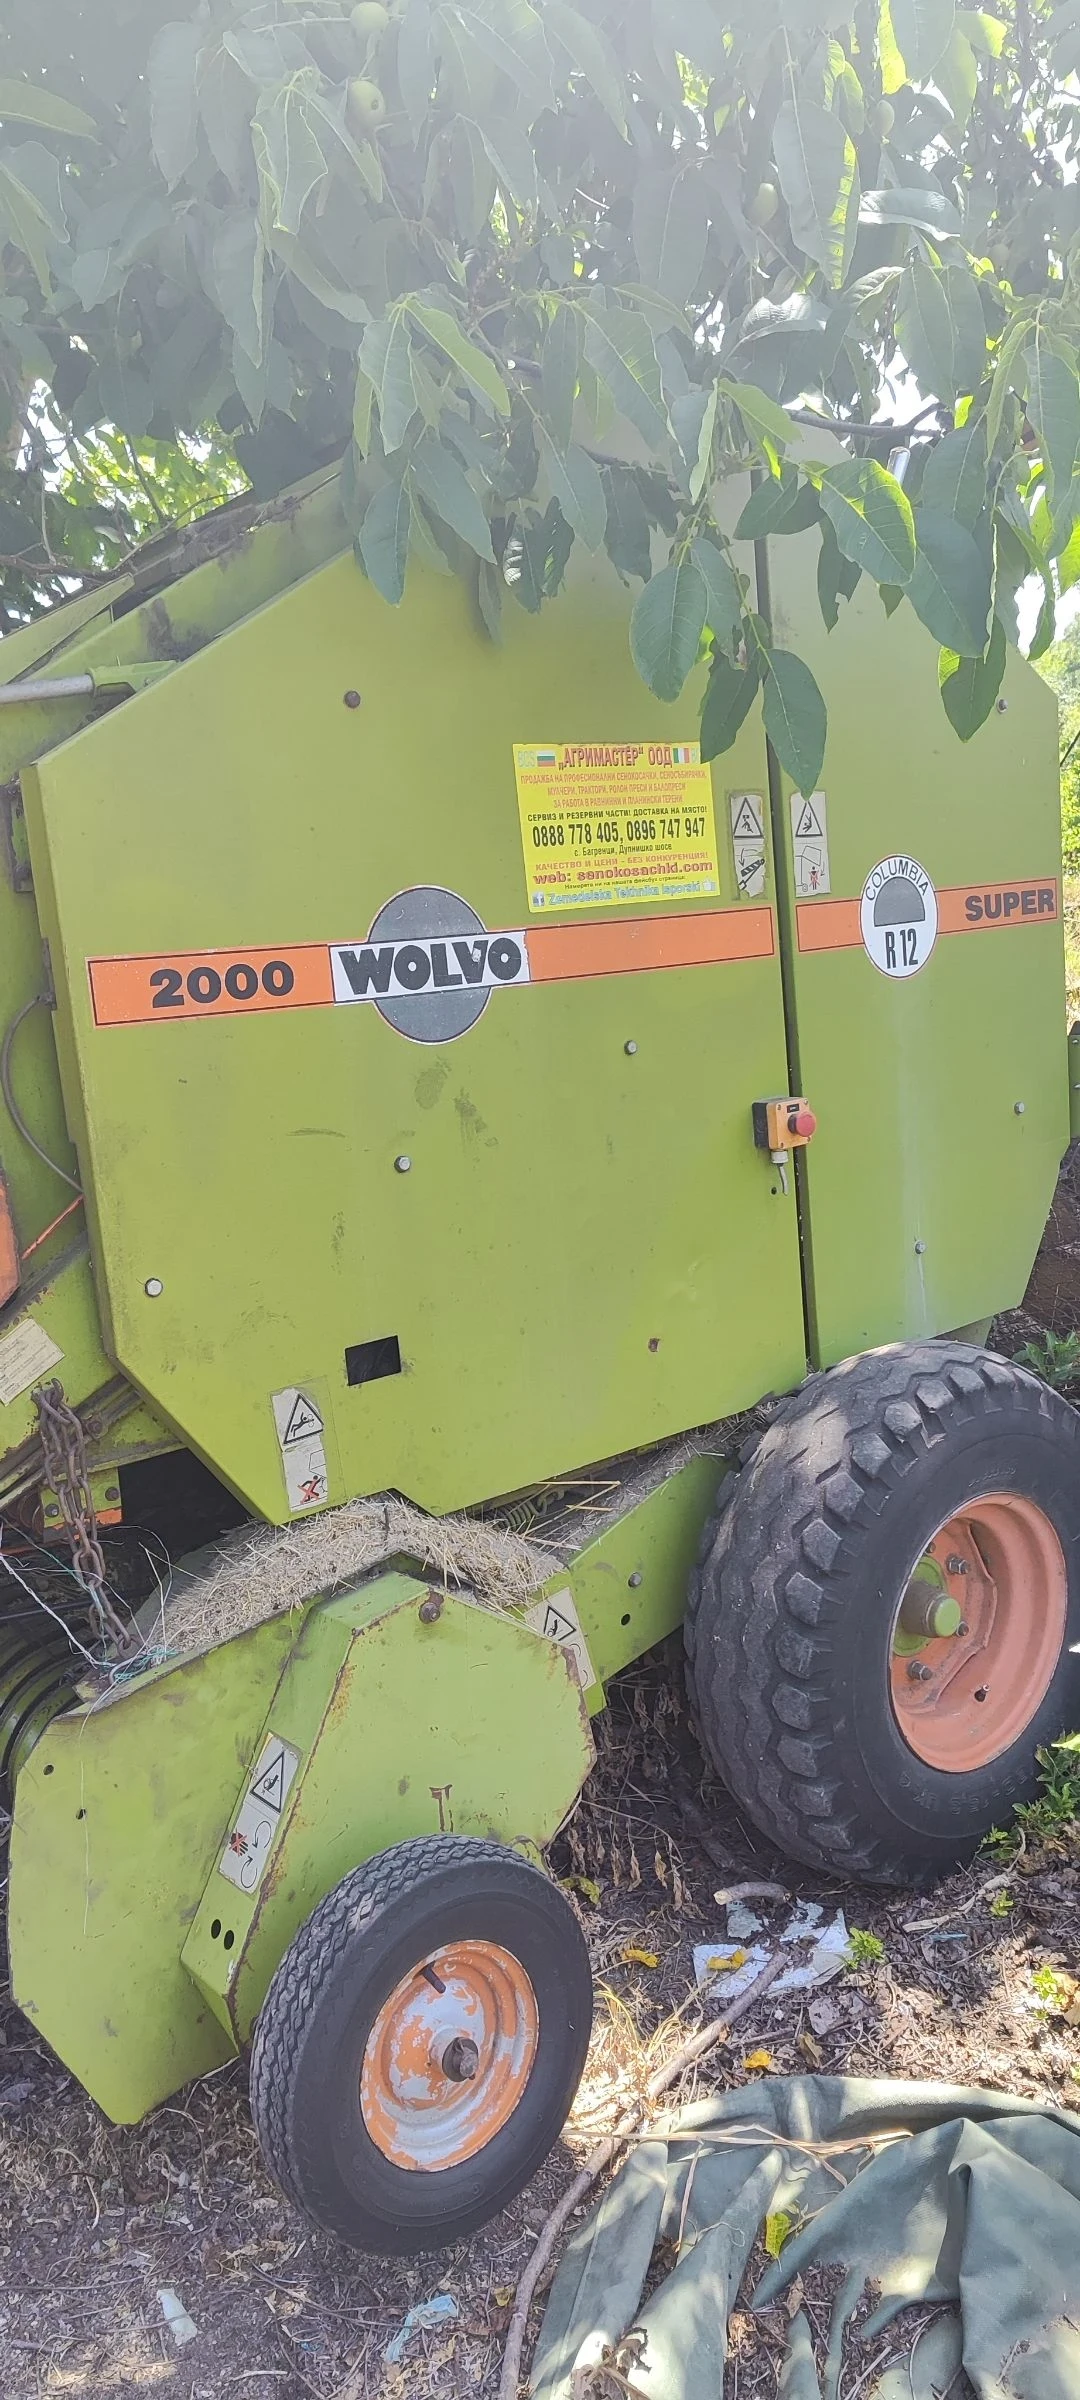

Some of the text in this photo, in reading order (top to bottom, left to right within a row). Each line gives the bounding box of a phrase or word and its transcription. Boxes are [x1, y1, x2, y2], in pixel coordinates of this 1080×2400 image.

[648, 746, 672, 769] ООД
[520, 774, 553, 785] ПРОДАЖБА
[555, 774, 563, 783] НА
[564, 772, 616, 783] ПРОФЕСИОНАЛНИ
[609, 784, 628, 793] РОЛОН
[629, 783, 648, 792] ПРЕСИ
[648, 783, 653, 792] И
[654, 782, 686, 792] БАЛОПРЕСИ
[553, 794, 682, 809] ЗА РАБОТА В РАВНИННИ И ПЛАНИНСКИ ТЕРЕНИ
[527, 813, 557, 821] СЕРВИЗ
[559, 812, 564, 820] И
[567, 811, 603, 819] РЕЗЕРВНИ
[605, 809, 631, 817] ЧАСТИ!
[633, 807, 669, 816] ДОСТАВКА
[681, 806, 707, 814] МЯСТО!
[532, 816, 705, 847] 0888 778 405, 0896 747 947
[535, 860, 582, 871] КАЧЕСТВО
[594, 858, 618, 867] ЦЕНИ
[627, 856, 643, 864] БЕЗ
[645, 852, 709, 862] КОНКУРЕНЦИЯ!
[574, 843, 672, 857] с. Багренци, Дупнишко шосе
[533, 861, 713, 884] web: senokosachki.com
[865, 858, 930, 902] COLUMBIA
[965, 888, 1055, 922] SUPER
[885, 928, 919, 969] R 12
[148, 937, 525, 1008] 2000 WOLVO
